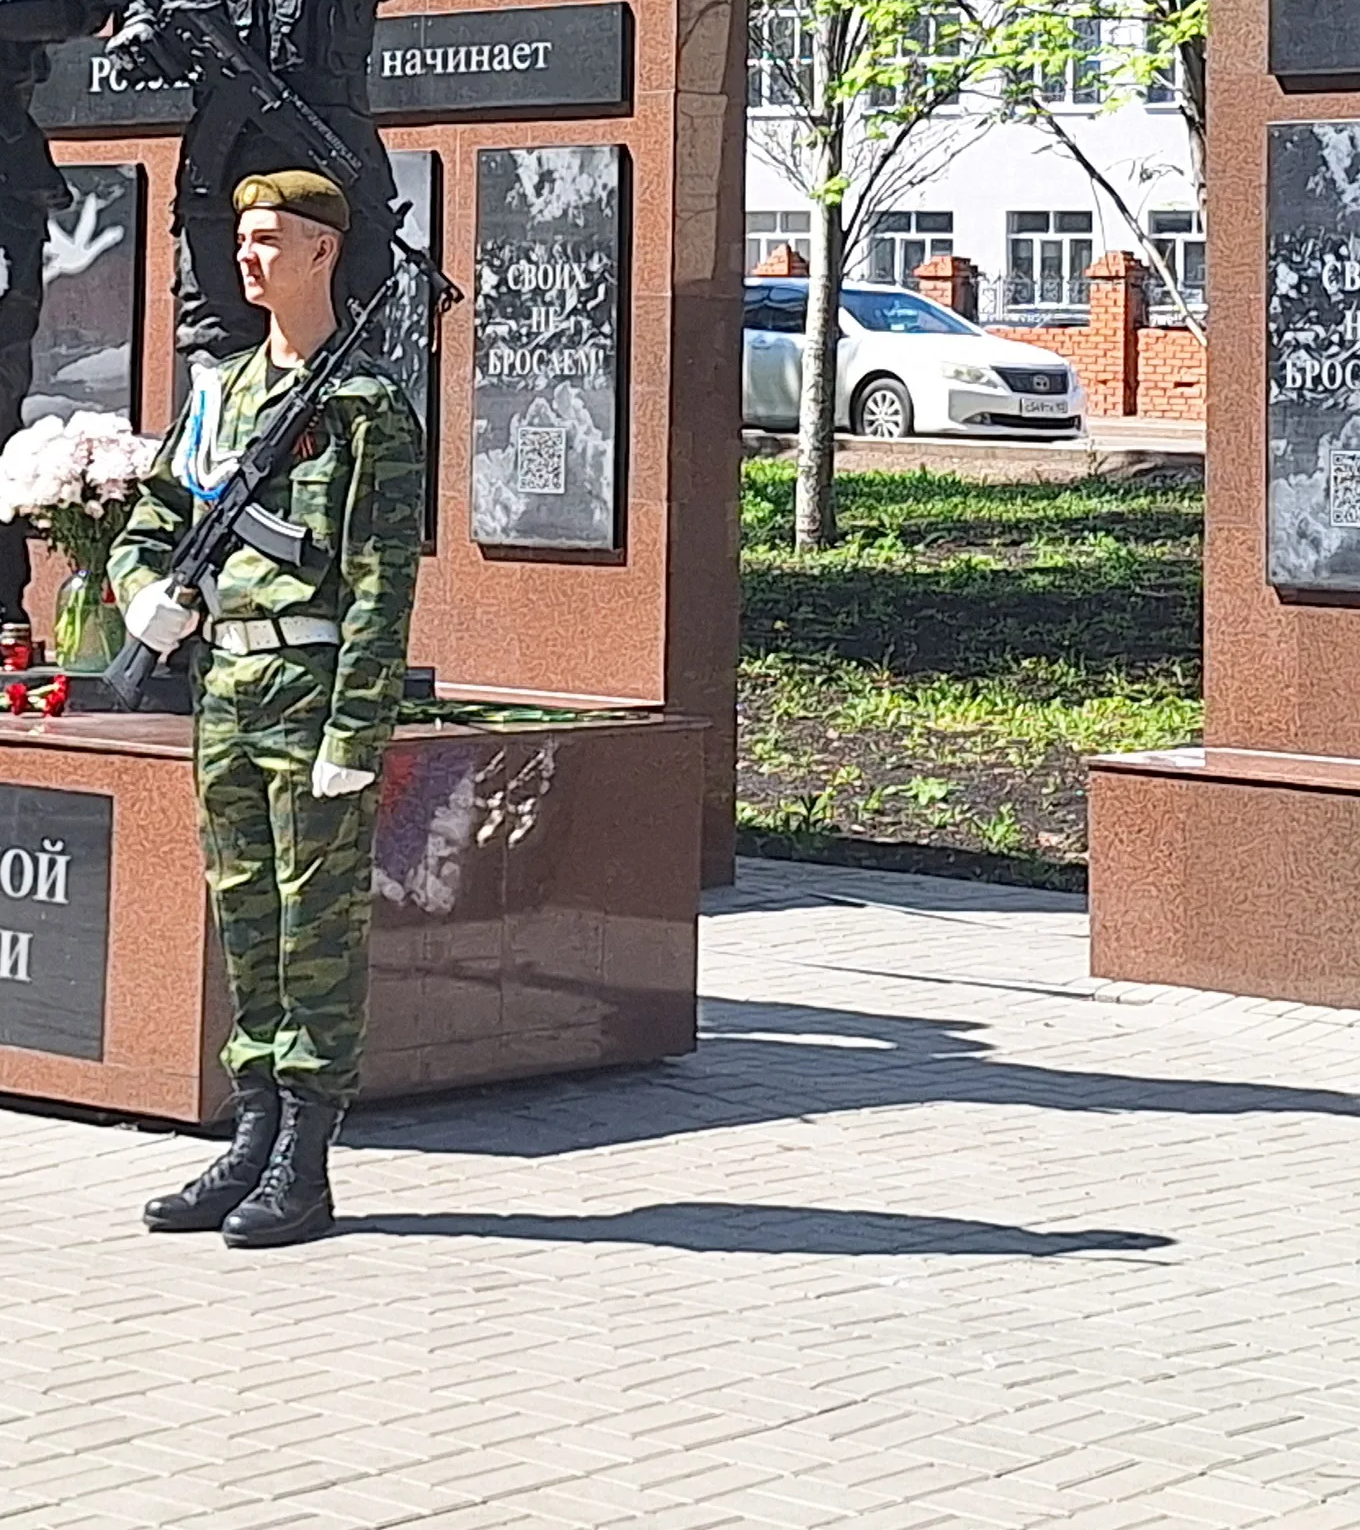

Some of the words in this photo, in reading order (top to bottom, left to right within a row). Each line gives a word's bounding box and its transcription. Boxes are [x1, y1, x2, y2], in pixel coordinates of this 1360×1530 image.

[382, 41, 552, 78] начинает
[508, 263, 588, 291] СВОИХ
[531, 306, 562, 333] НЕ
[488, 348, 605, 376] БРОСАЕМ!
